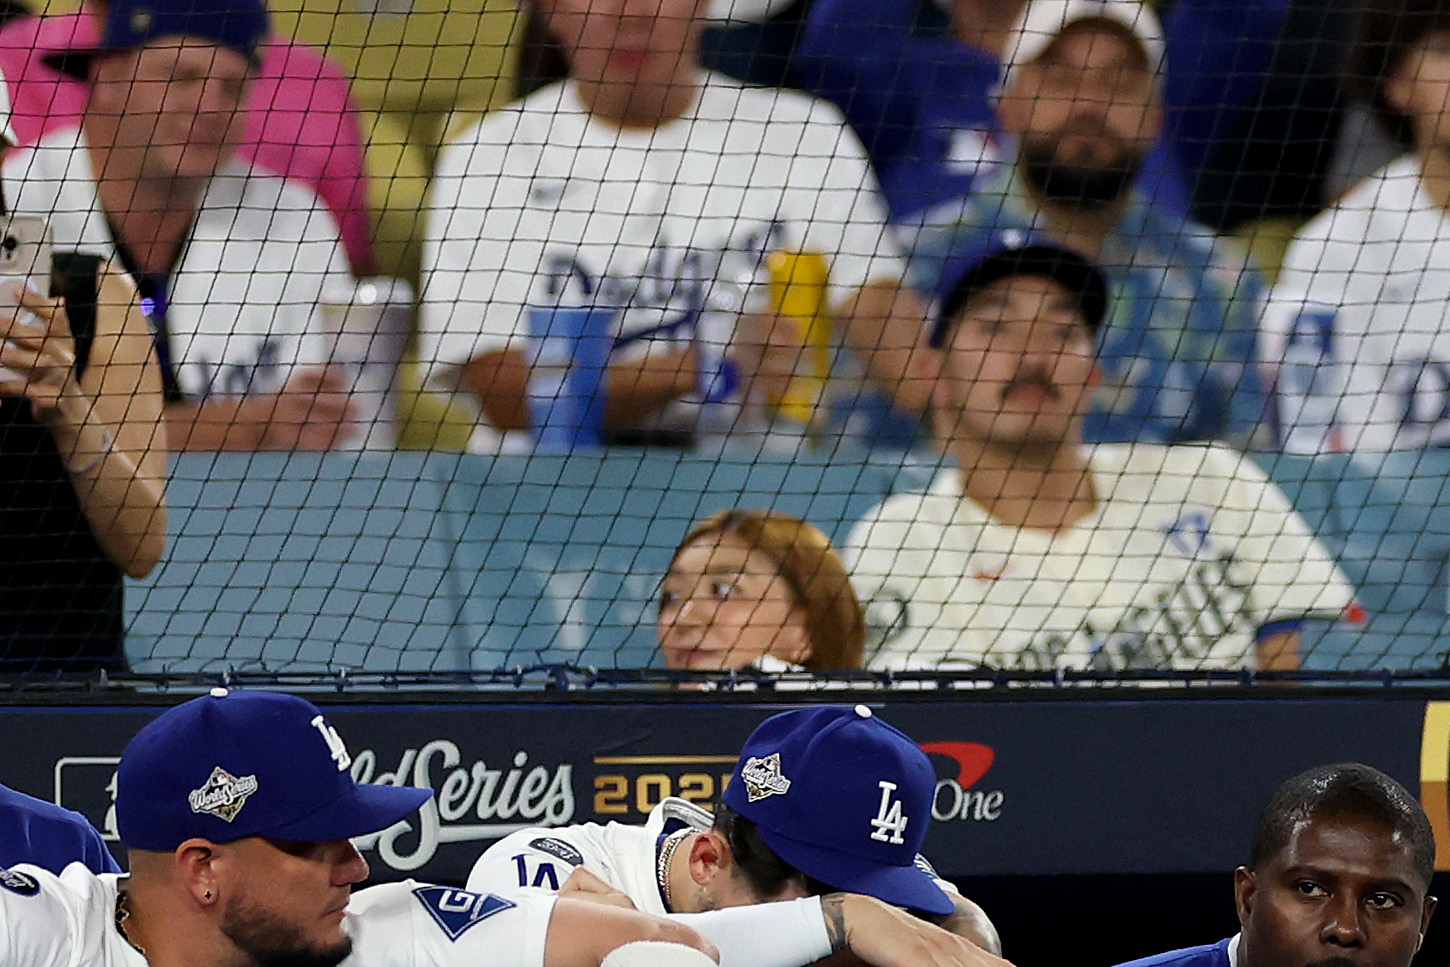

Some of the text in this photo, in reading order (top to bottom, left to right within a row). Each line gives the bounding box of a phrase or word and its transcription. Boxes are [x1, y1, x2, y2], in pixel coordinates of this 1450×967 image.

[594, 773, 735, 815] 202
[871, 781, 908, 844] LA
[931, 779, 1003, 822] One
